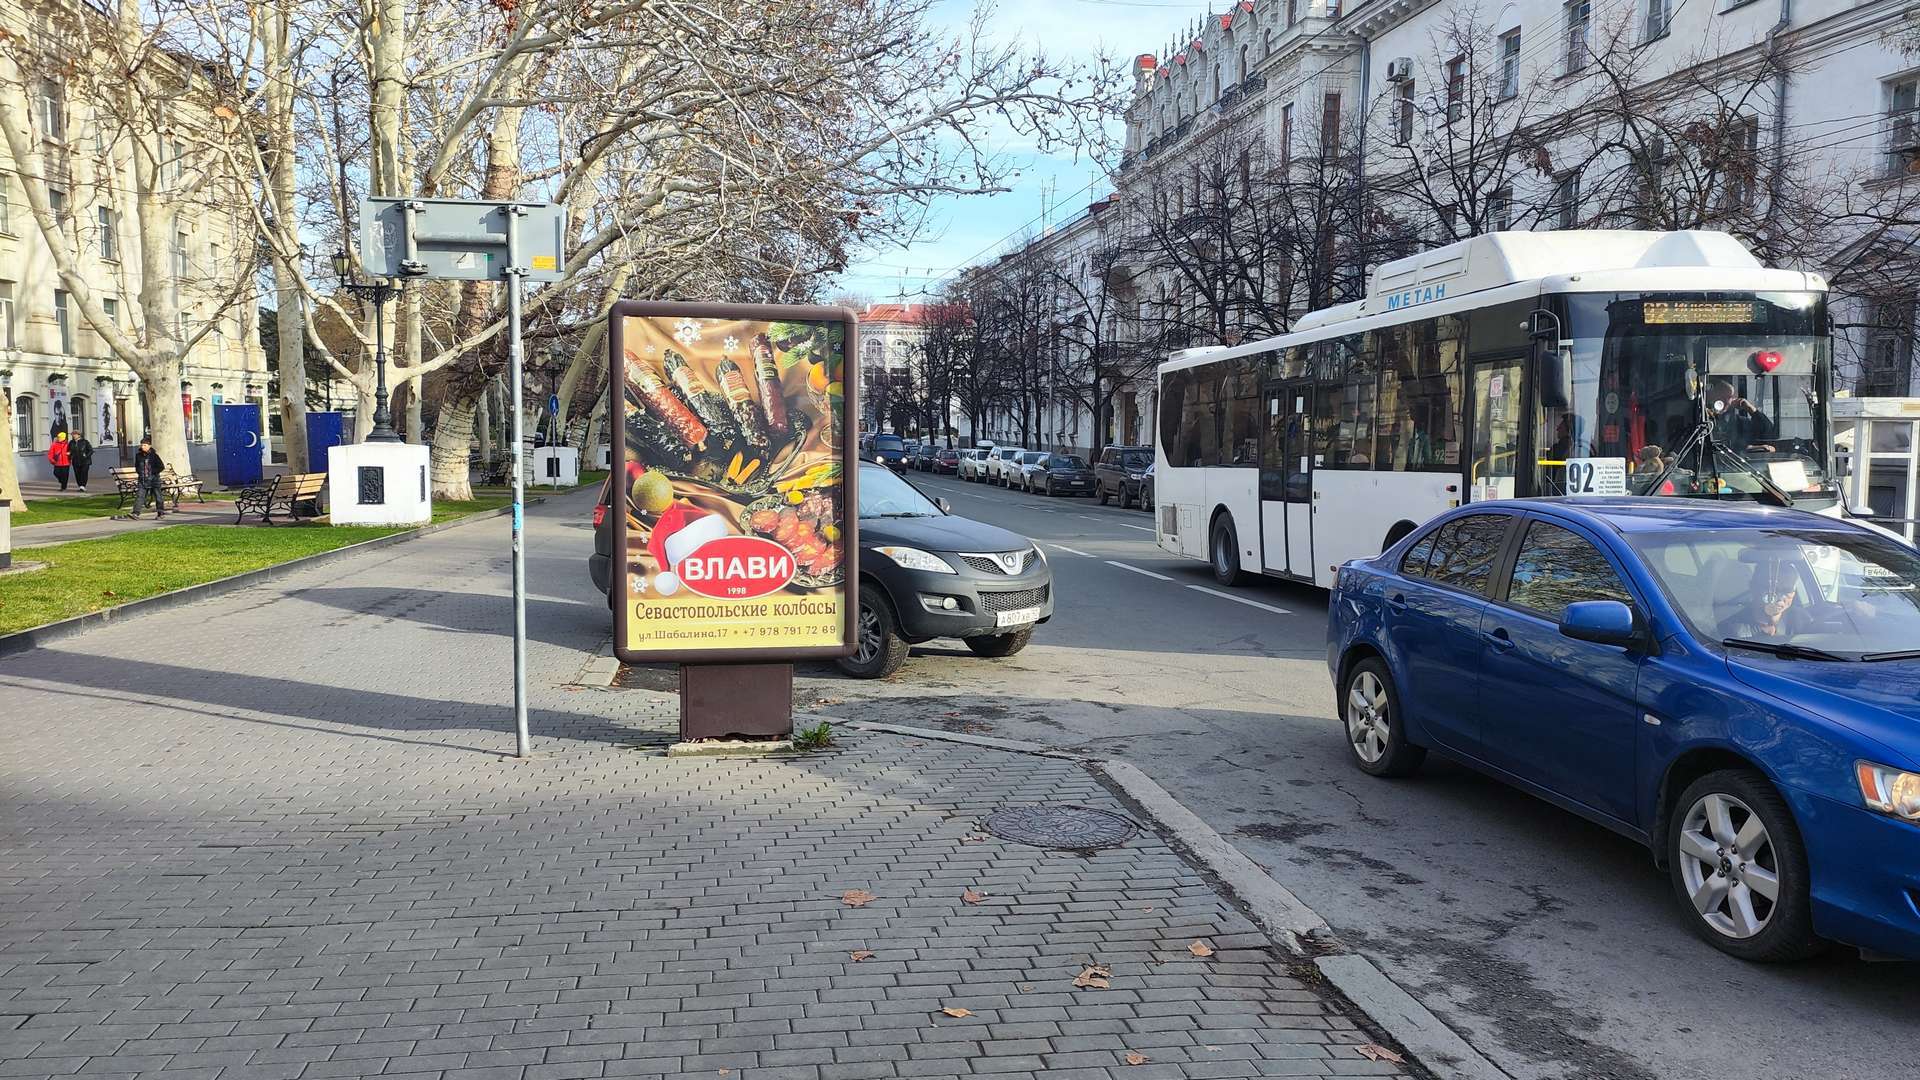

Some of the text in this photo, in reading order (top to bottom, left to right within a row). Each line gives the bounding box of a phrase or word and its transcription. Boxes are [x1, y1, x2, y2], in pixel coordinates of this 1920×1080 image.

[1388, 283, 1446, 309] МЕТАН
[1569, 463, 1594, 493] 92
[685, 556, 788, 580] ВЛАВИ
[727, 587, 747, 595] 1998
[635, 598, 836, 620] Севастопольские колбасы
[744, 627, 755, 636] +7
[759, 627, 779, 636] 978
[784, 626, 801, 635] 791
[805, 626, 818, 634] 72
